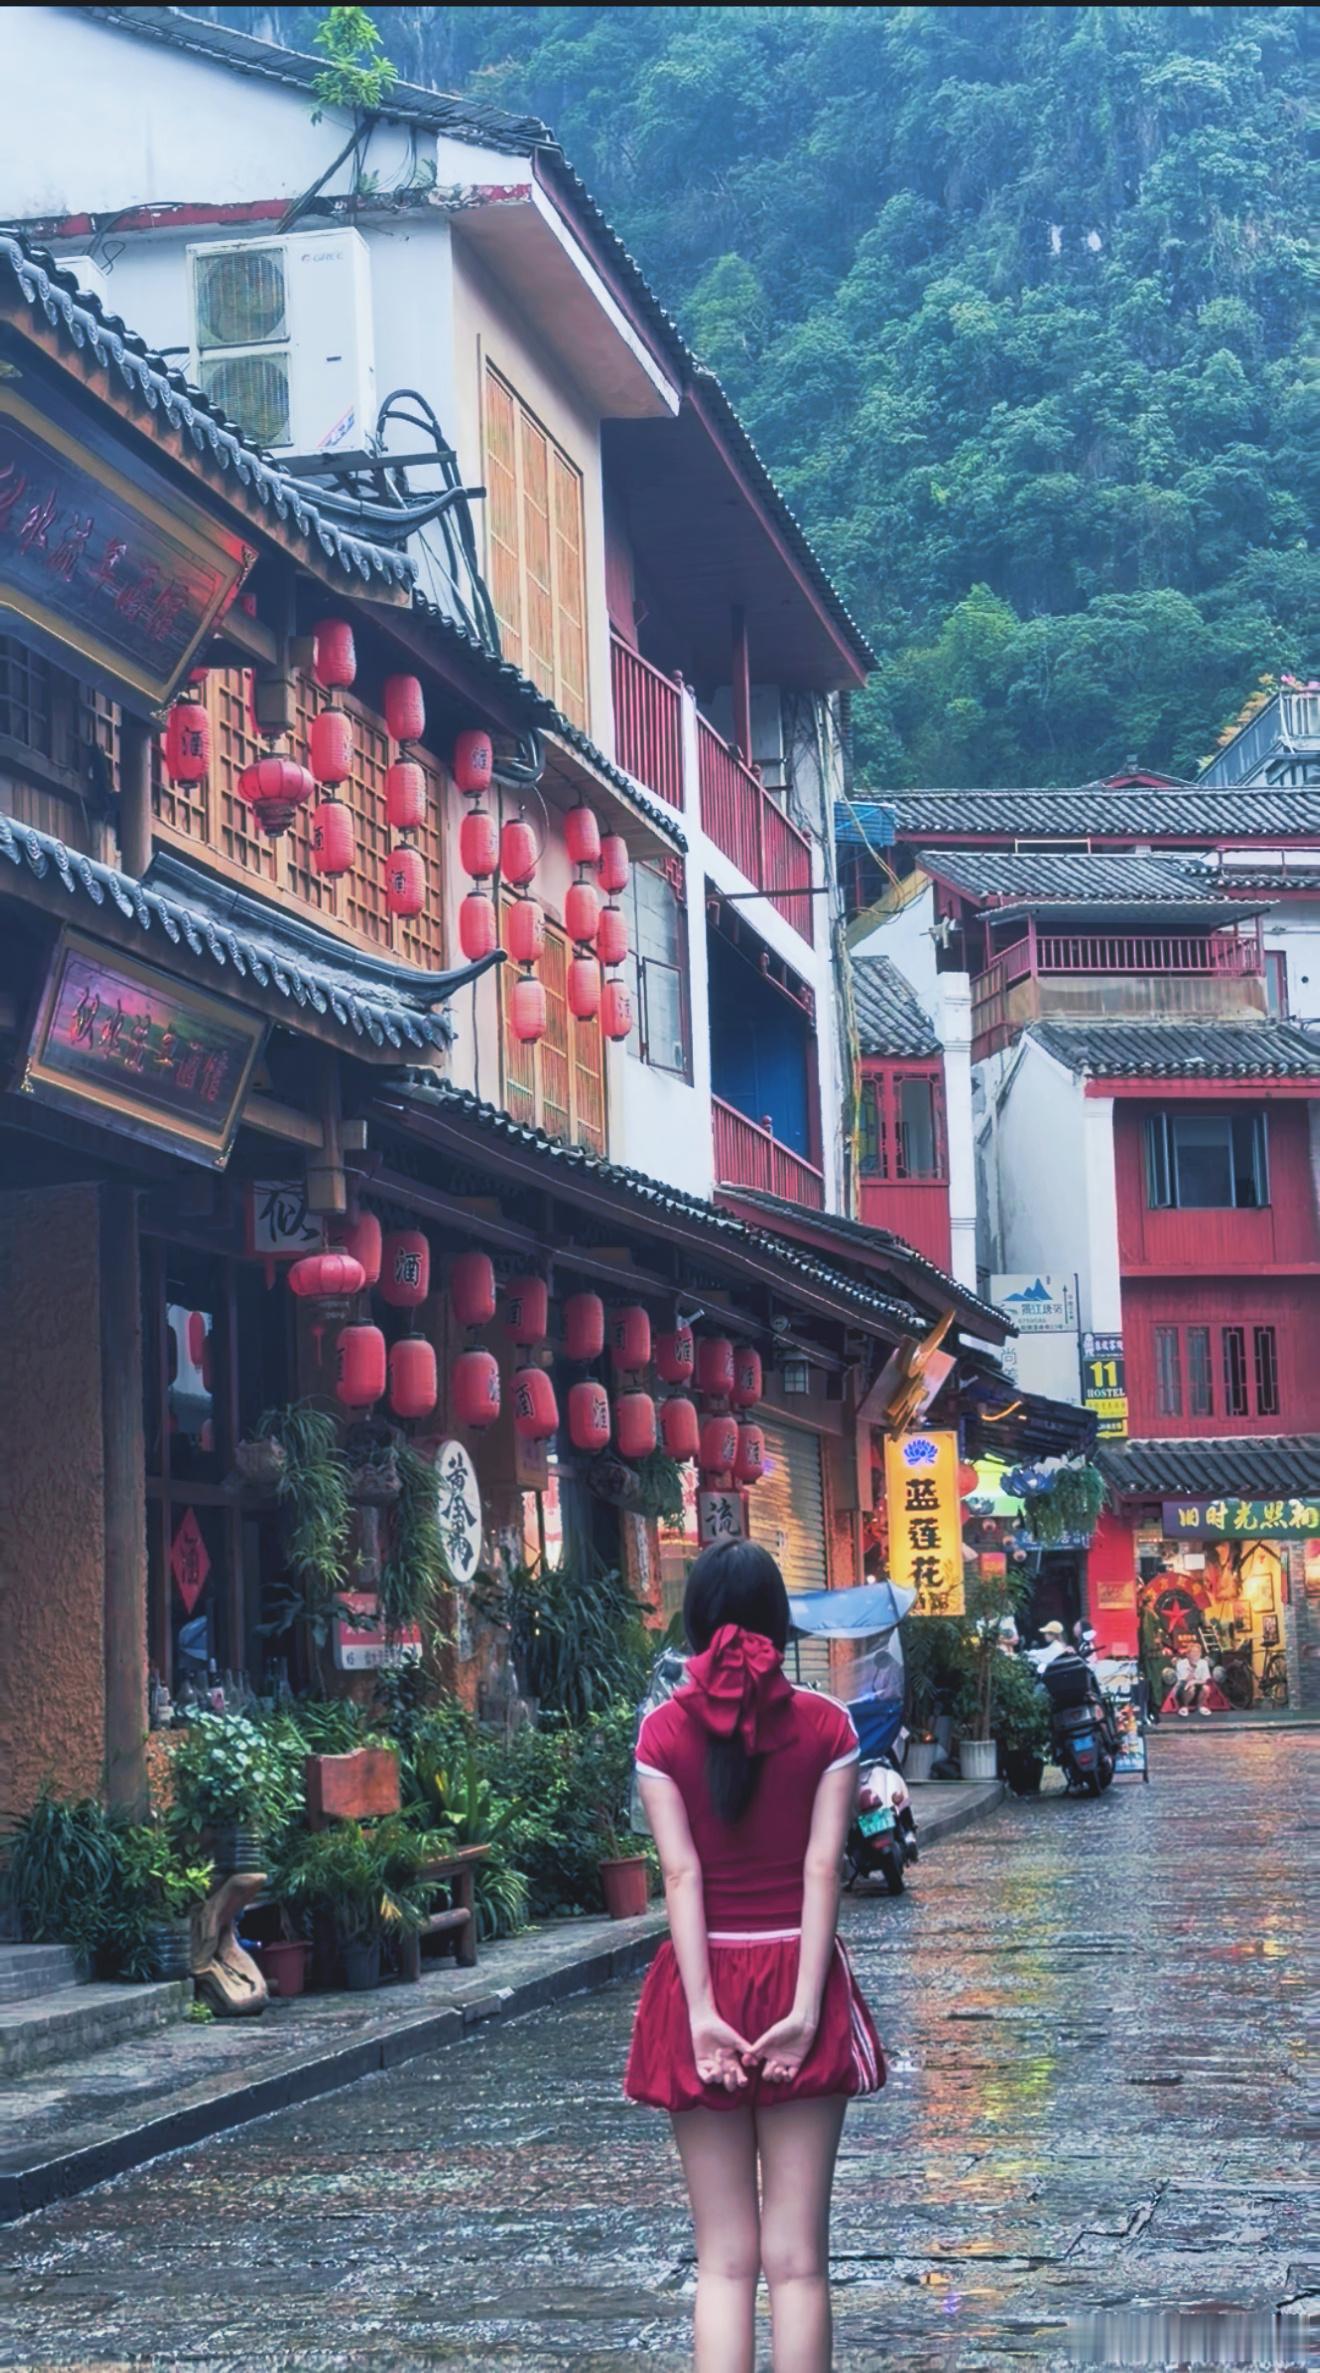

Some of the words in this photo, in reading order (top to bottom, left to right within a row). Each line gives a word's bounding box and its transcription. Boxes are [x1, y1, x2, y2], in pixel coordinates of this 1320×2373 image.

[395, 1250, 421, 1288] 酒
[675, 1337, 693, 1363] 酒
[1090, 1361, 1117, 1388] 11
[1087, 1388, 1125, 1398] HOSTEL
[593, 1396, 608, 1429] 酒
[747, 1439, 761, 1465] 酒
[706, 1499, 740, 1537] 流
[1178, 1499, 1320, 1530] 旧时光照相
[905, 1478, 943, 1588] 蓝莲花
